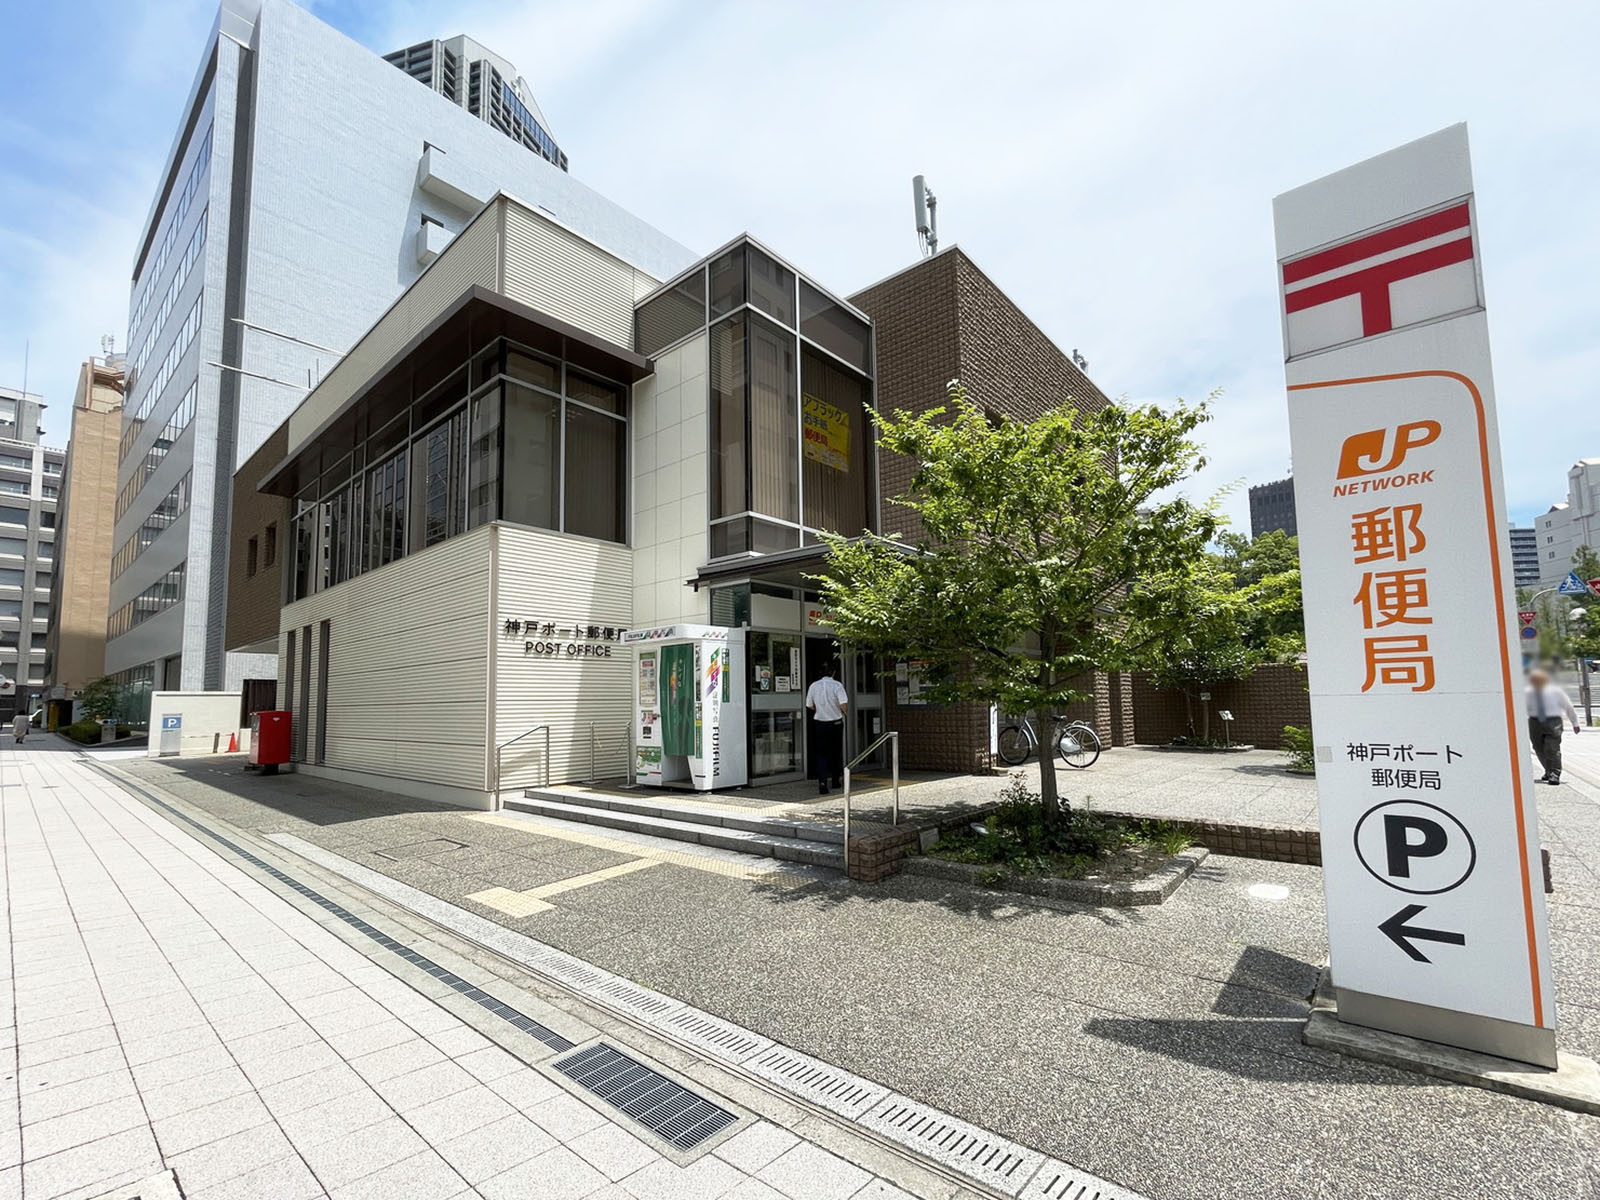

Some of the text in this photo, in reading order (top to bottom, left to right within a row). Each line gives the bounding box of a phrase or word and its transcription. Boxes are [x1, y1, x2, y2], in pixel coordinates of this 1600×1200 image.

[1336, 419, 1442, 480] JP
[1333, 469, 1435, 497] NETWORK
[1351, 503, 1436, 693] 郵便局
[525, 641, 612, 657] POST OFFICE
[1346, 742, 1463, 764] 神戸ポート
[1371, 768, 1441, 790] 郵便局
[1383, 814, 1448, 878] P
